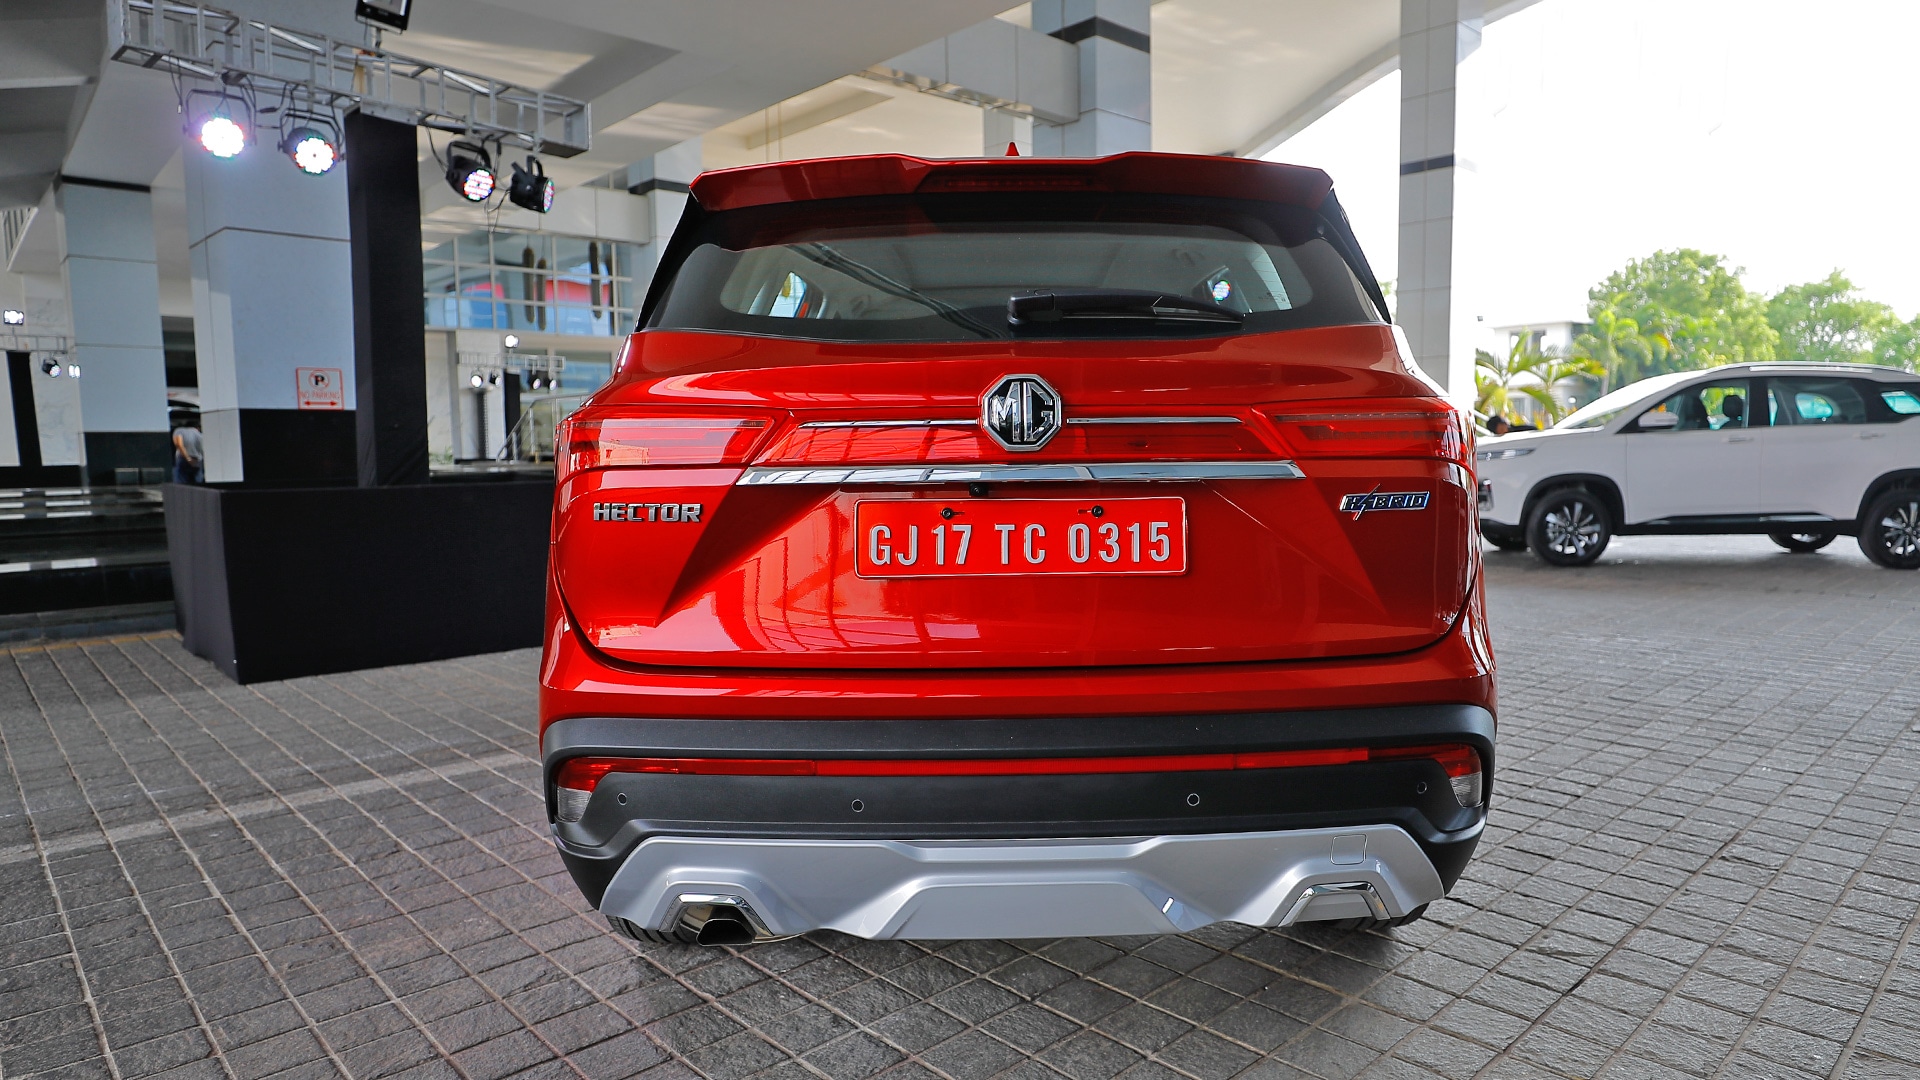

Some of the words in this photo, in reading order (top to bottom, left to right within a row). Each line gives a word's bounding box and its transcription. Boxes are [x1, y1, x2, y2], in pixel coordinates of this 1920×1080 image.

[990, 382, 1053, 442] MG
[593, 502, 702, 523] HECTOR
[869, 524, 918, 566] GJ
[931, 523, 972, 565] 17
[994, 523, 1046, 565] TC
[1067, 521, 1171, 564] 0315
